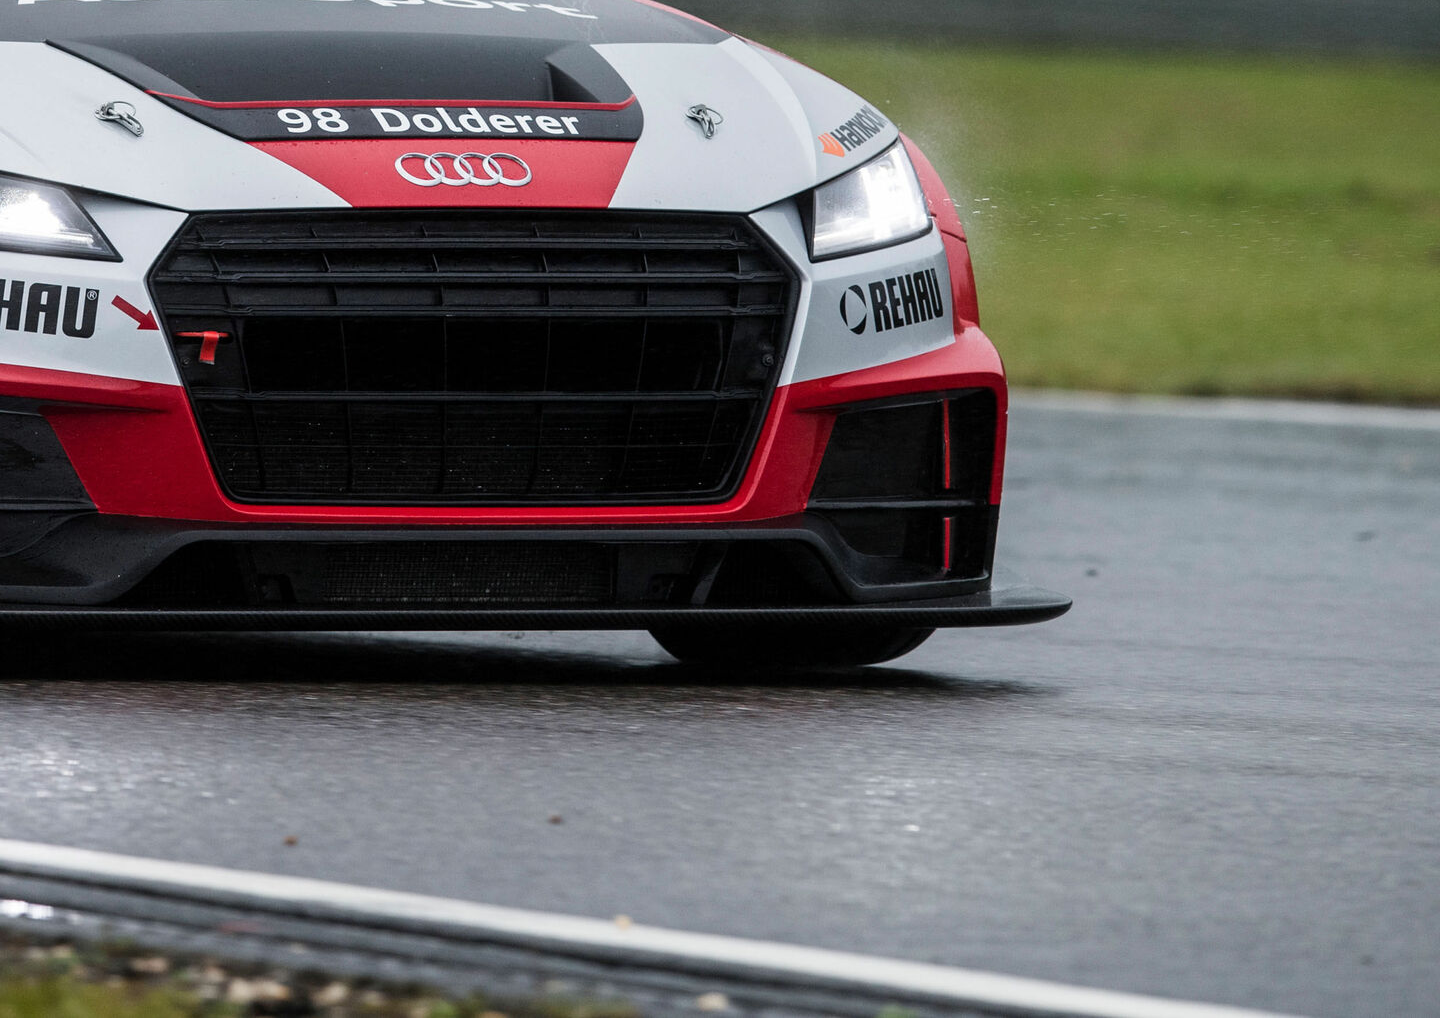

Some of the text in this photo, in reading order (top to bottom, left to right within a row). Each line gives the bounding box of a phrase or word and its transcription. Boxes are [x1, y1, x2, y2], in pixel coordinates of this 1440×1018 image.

[276, 108, 580, 137] 98 Dolderer
[868, 268, 944, 333] REHAU
